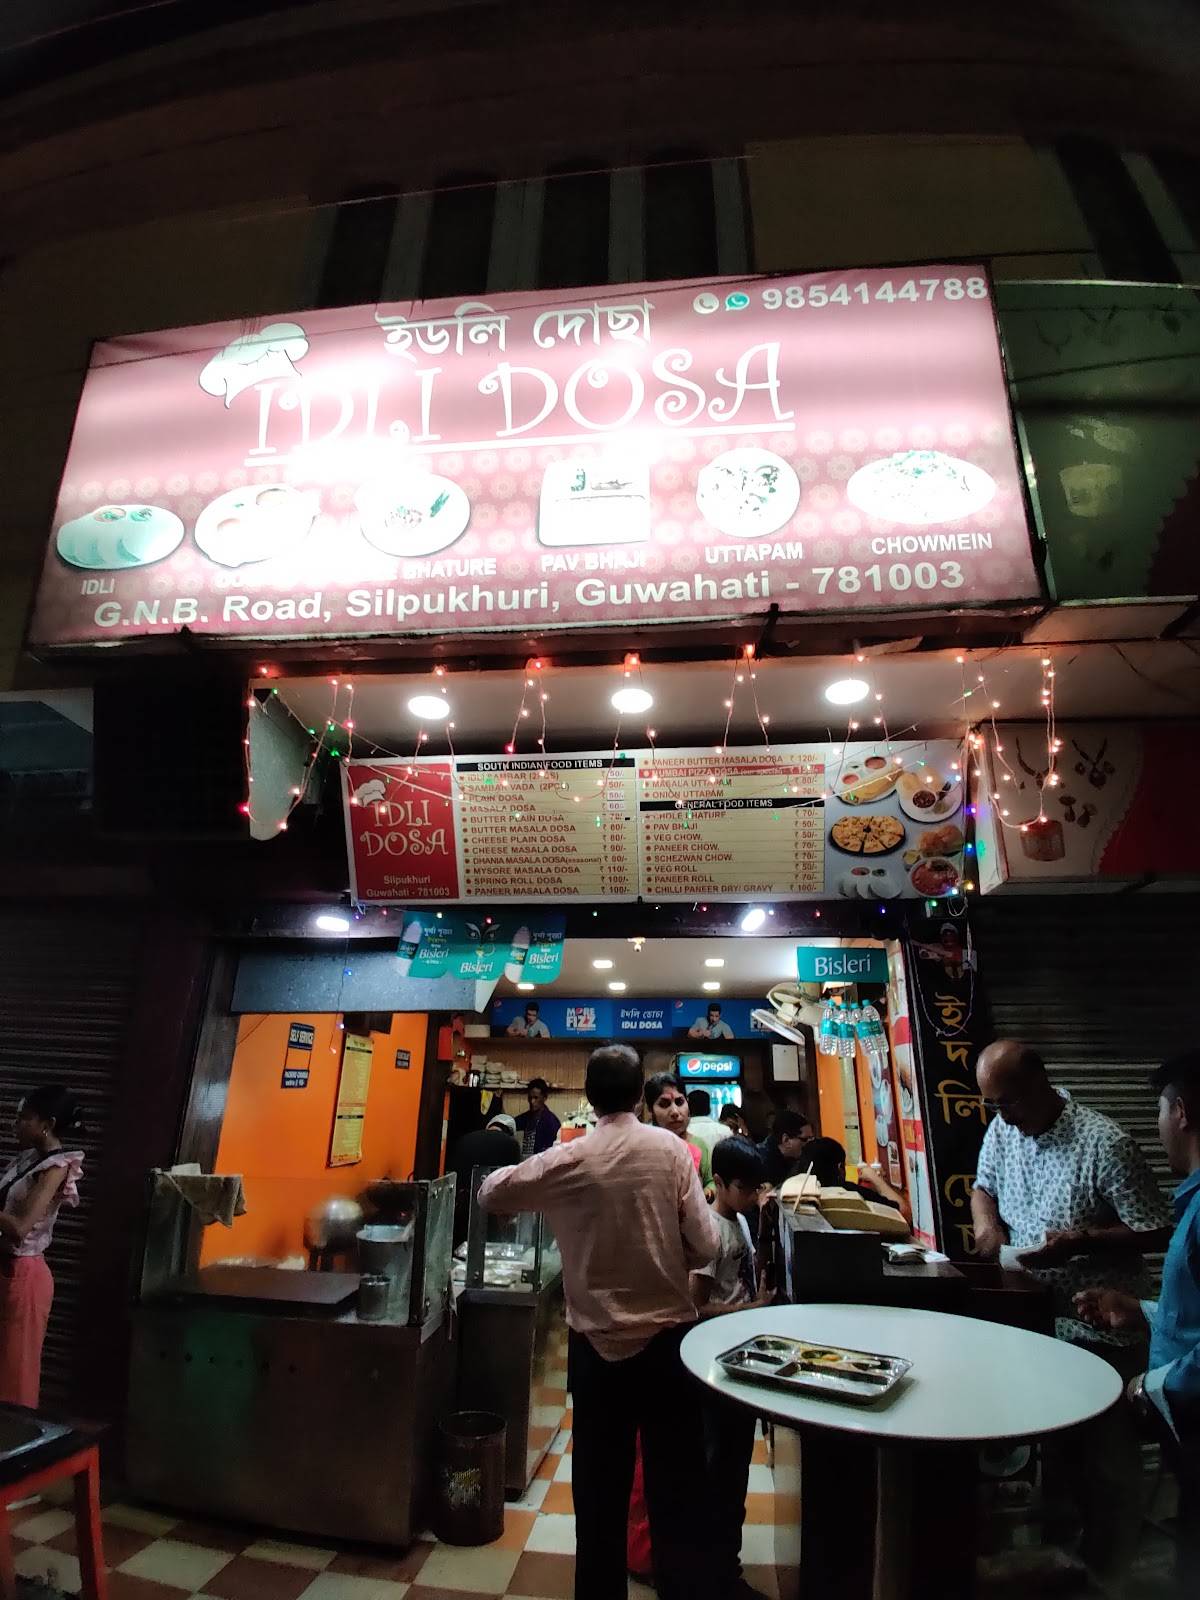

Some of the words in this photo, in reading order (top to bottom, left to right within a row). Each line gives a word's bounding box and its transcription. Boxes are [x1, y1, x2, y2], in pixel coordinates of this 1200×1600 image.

[762, 277, 988, 310] 9854144788
[375, 301, 511, 362] ইডলি
[533, 299, 655, 349] দোছা
[248, 366, 442, 456] IDLI
[478, 341, 795, 438] DOSA
[871, 532, 993, 556] CHOWMEIN
[704, 541, 803, 564] UTTAPAM
[541, 551, 580, 572] PAV
[81, 578, 115, 596] IDLI
[94, 596, 209, 627] G.N.B.
[222, 590, 331, 624] Road,
[346, 578, 560, 619] Silpukhuri,
[575, 569, 771, 607] Guwahati
[812, 560, 965, 595] 781003
[477, 762, 510, 771] SOUTH
[511, 761, 545, 770] INDIAN
[545, 760, 572, 769] FOOD
[574, 760, 603, 768] ITEMS
[687, 757, 720, 766] BUTTER
[721, 755, 757, 765] MASALA
[688, 767, 712, 776] PIZZA
[714, 766, 739, 775] DOSA
[510, 783, 535, 791] VADA
[540, 782, 570, 791] (2PC)
[498, 794, 525, 802] DOSA
[652, 791, 681, 799] ONION
[683, 789, 724, 797] UTTAPAM
[510, 804, 536, 812] DOSA
[675, 800, 715, 809] GENERAL
[719, 800, 744, 809] FOOD
[746, 799, 773, 808] ITEMS
[372, 799, 433, 827] IDLI
[471, 826, 507, 834] BUTTER
[509, 825, 547, 833] MASALA
[549, 824, 576, 832] DOSA
[653, 823, 670, 831] PAV
[359, 828, 450, 857] DOSA
[471, 836, 508, 844] CHEESE
[540, 835, 566, 843] DOSA
[653, 834, 672, 842] VEG
[472, 847, 509, 855] CHEESE
[511, 846, 549, 854] MASALA
[551, 845, 577, 853] DOSA
[653, 844, 689, 852] PANEER
[506, 856, 541, 864] MASALA
[654, 855, 703, 863] SCHEZWAN
[473, 867, 512, 875] MYSORE
[554, 866, 580, 874] DOSA
[654, 865, 673, 873] VEG
[674, 865, 698, 873] ROLL
[474, 877, 508, 885] SPRING
[510, 877, 534, 885] ROLL
[536, 876, 563, 884] DOSA
[691, 875, 715, 883] ROLL
[366, 888, 410, 898] Guwahati
[418, 887, 450, 897] 781003
[474, 887, 512, 896] PANEER
[513, 887, 552, 895] MASALA
[553, 886, 579, 895] DOSA
[655, 886, 683, 894] CHILLI
[743, 884, 774, 892] GRAVY
[528, 951, 560, 965] Bisleri
[460, 961, 494, 974] Bisleri
[814, 953, 871, 977] Bisleri
[621, 1020, 638, 1030] IDLI
[638, 1020, 663, 1030] DOSA
[702, 1061, 733, 1073] pepsi
